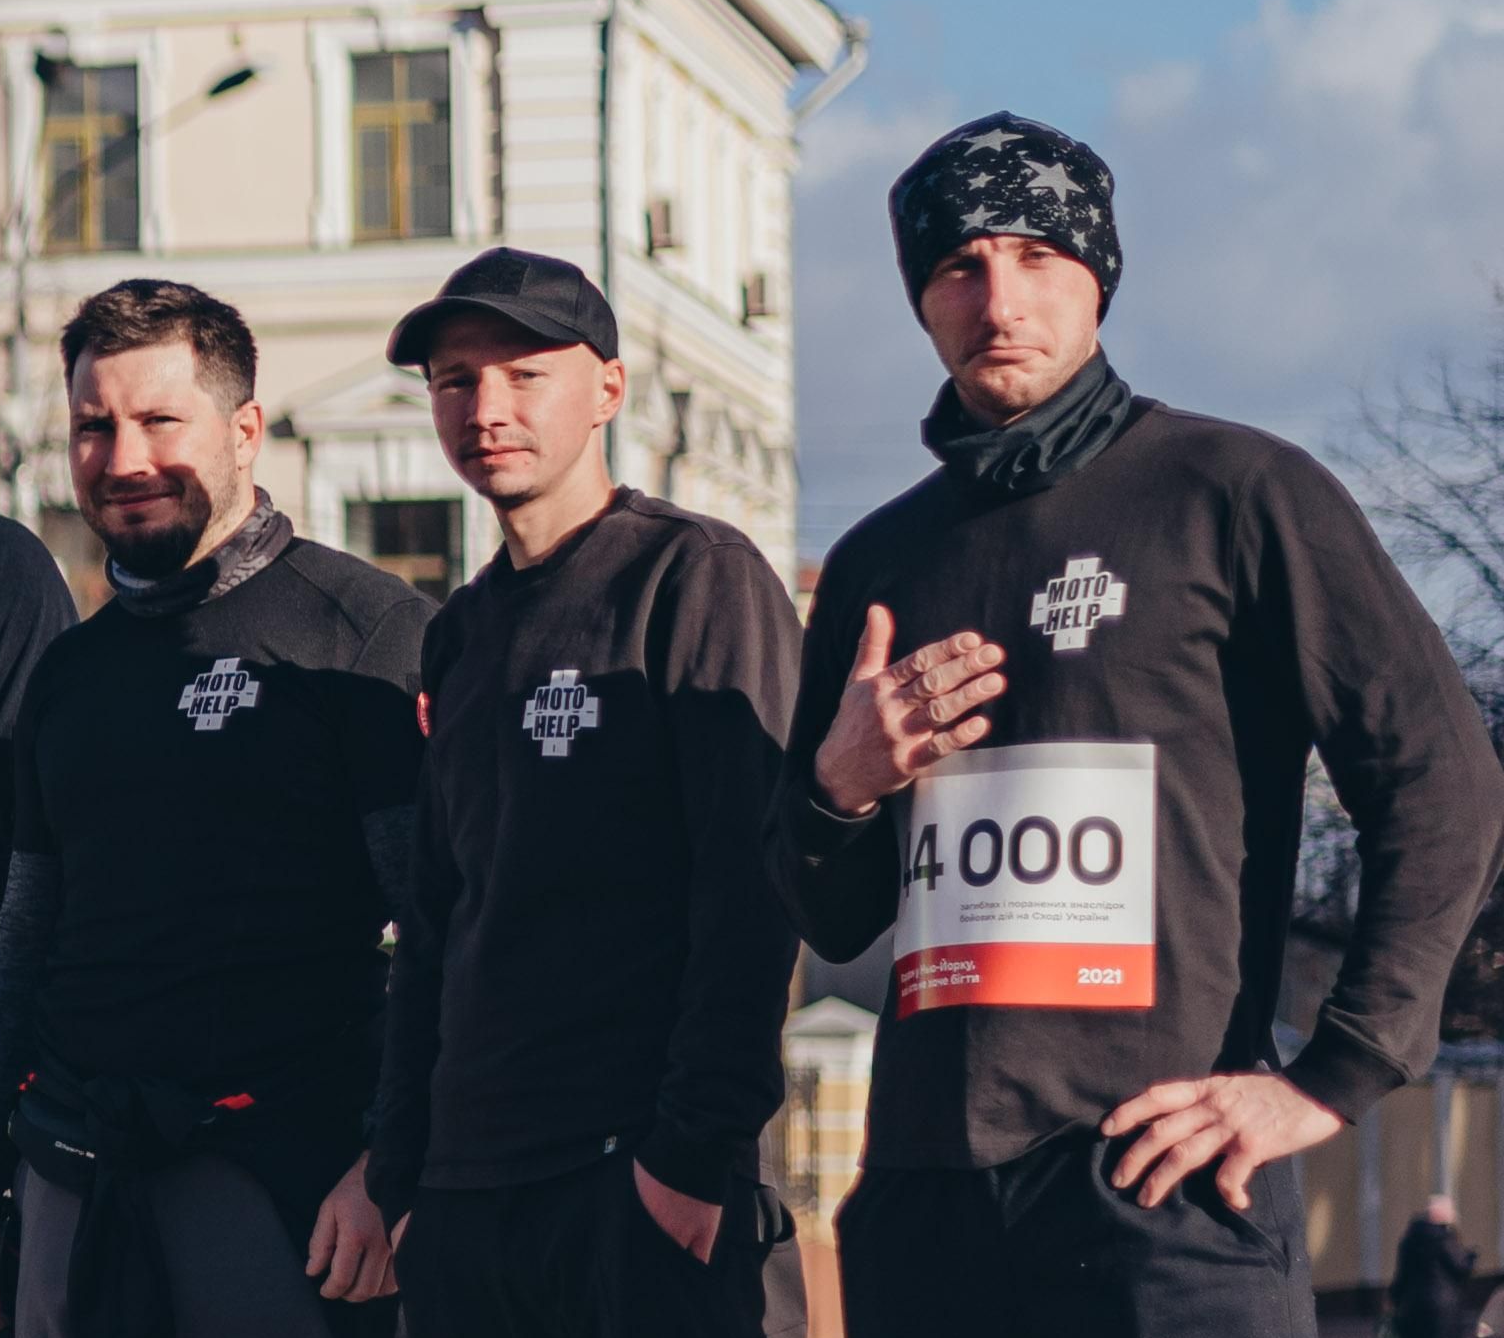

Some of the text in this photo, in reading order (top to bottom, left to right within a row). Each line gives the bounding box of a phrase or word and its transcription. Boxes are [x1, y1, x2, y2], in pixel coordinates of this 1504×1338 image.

[1048, 575, 1107, 604] MOTO
[1045, 603, 1101, 632] HELP
[194, 673, 248, 693] MOTO
[190, 695, 239, 715] HELP
[535, 687, 585, 710] MOTO
[534, 714, 580, 738] HELP
[959, 815, 1123, 887] 000
[1008, 901, 1067, 910] поранених
[1070, 901, 1125, 911] внаслідок
[998, 912, 1014, 921] дій
[1016, 913, 1029, 921] на
[1032, 912, 1063, 922] Сході
[1066, 912, 1110, 923] України
[950, 973, 980, 985] бігти
[1077, 968, 1123, 984] 2021
